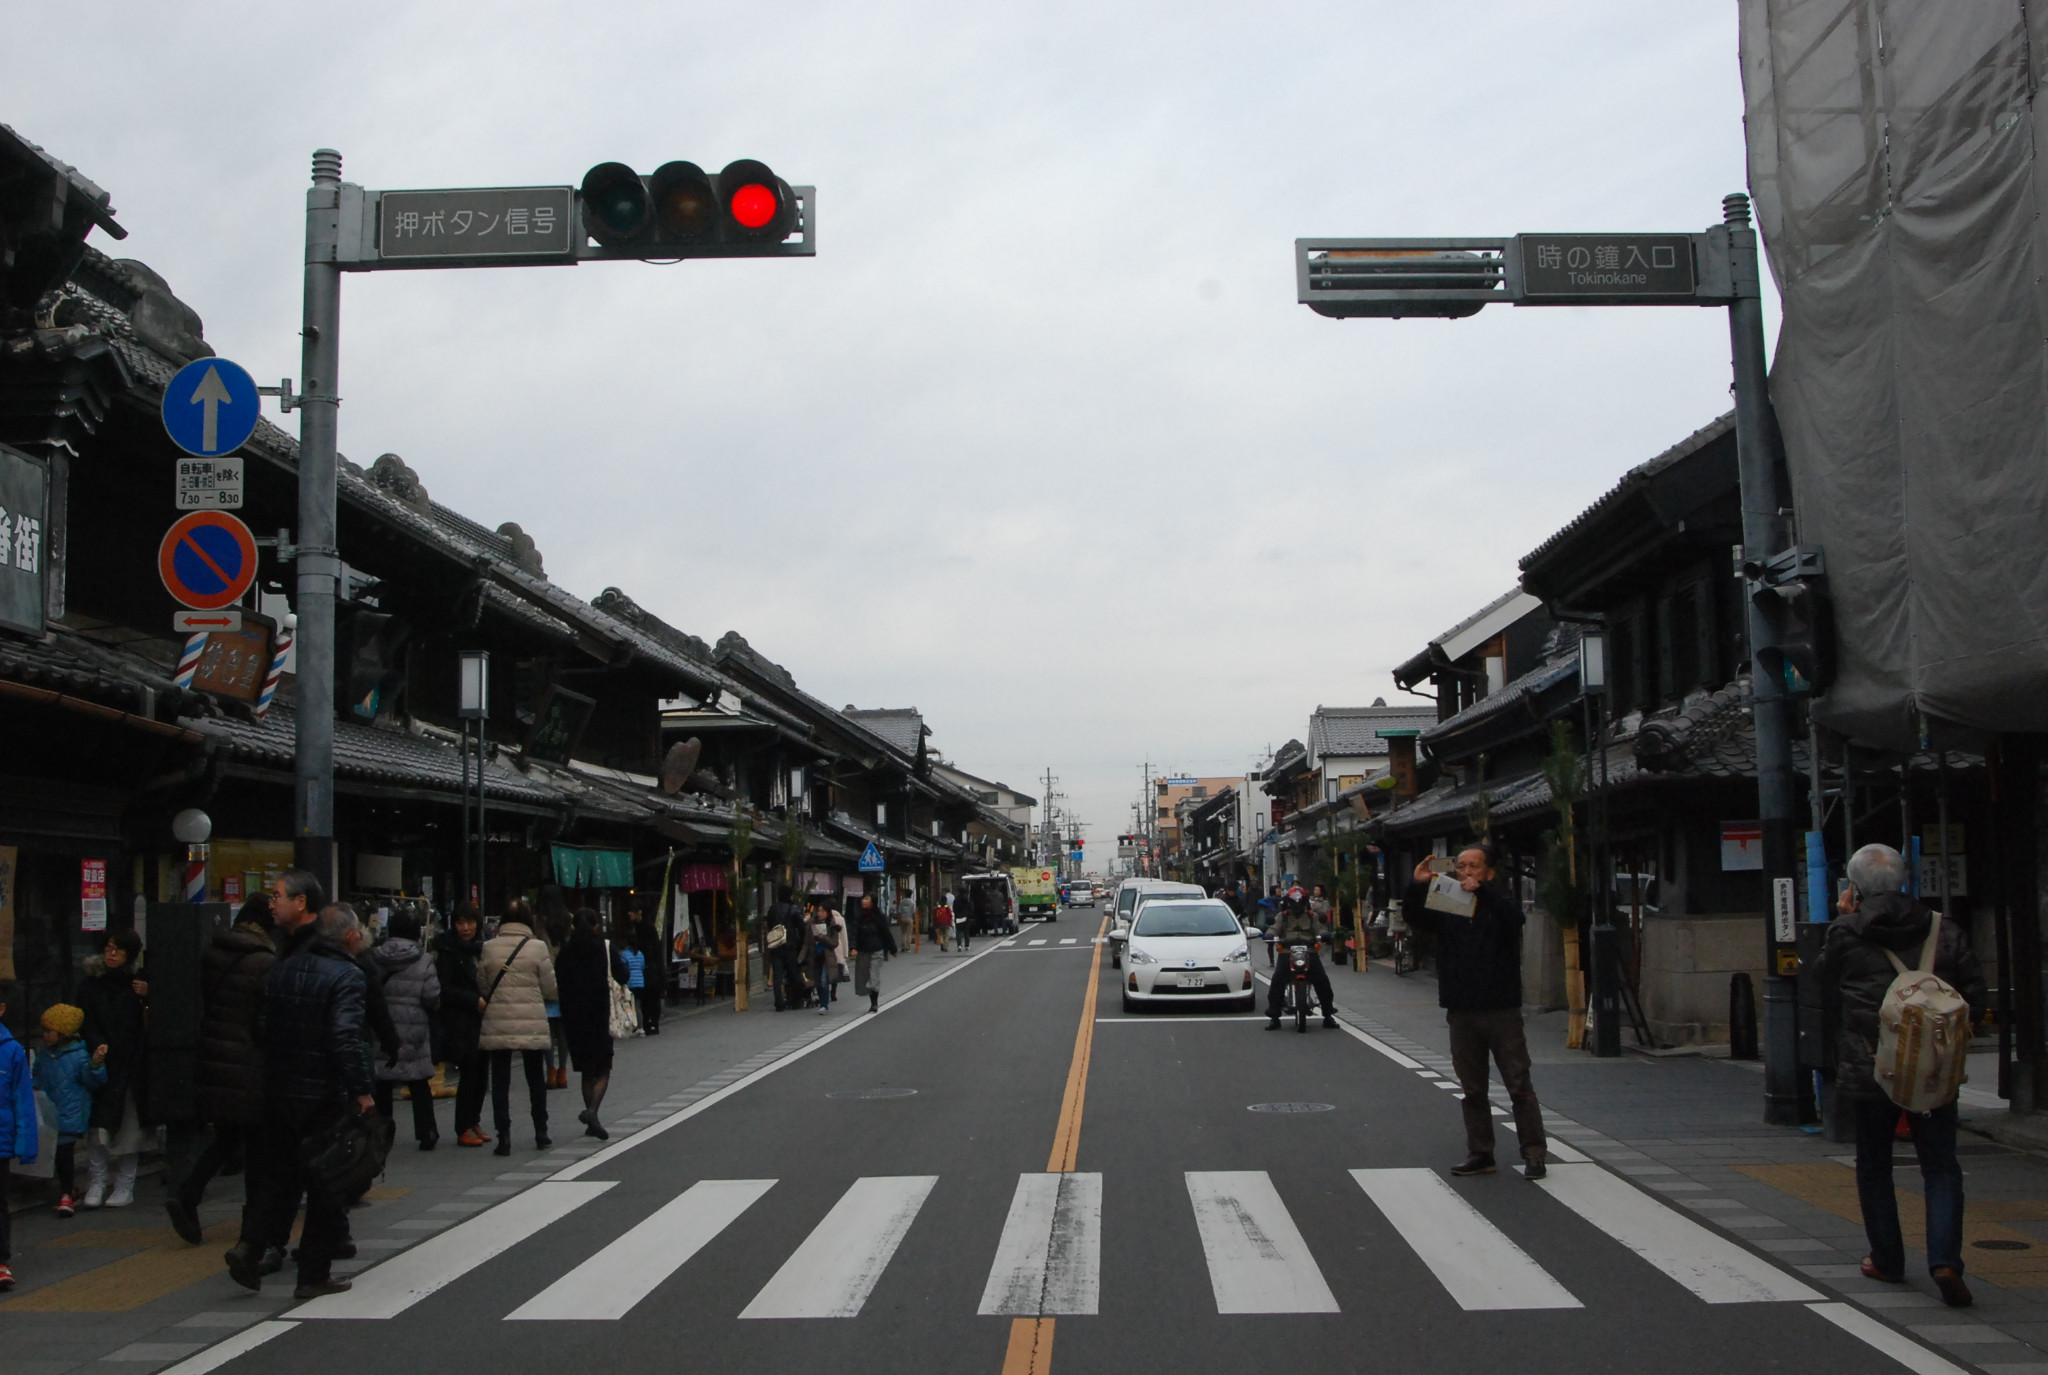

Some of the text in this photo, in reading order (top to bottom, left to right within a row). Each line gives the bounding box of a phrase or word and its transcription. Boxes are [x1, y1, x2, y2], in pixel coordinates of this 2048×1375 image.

[393, 207, 558, 238] 押ボタン信号
[1537, 244, 1677, 270] 時の鐘入口
[1568, 271, 1648, 286] Tokinokane
[181, 462, 212, 475] 自転車
[216, 468, 239, 481] を除く
